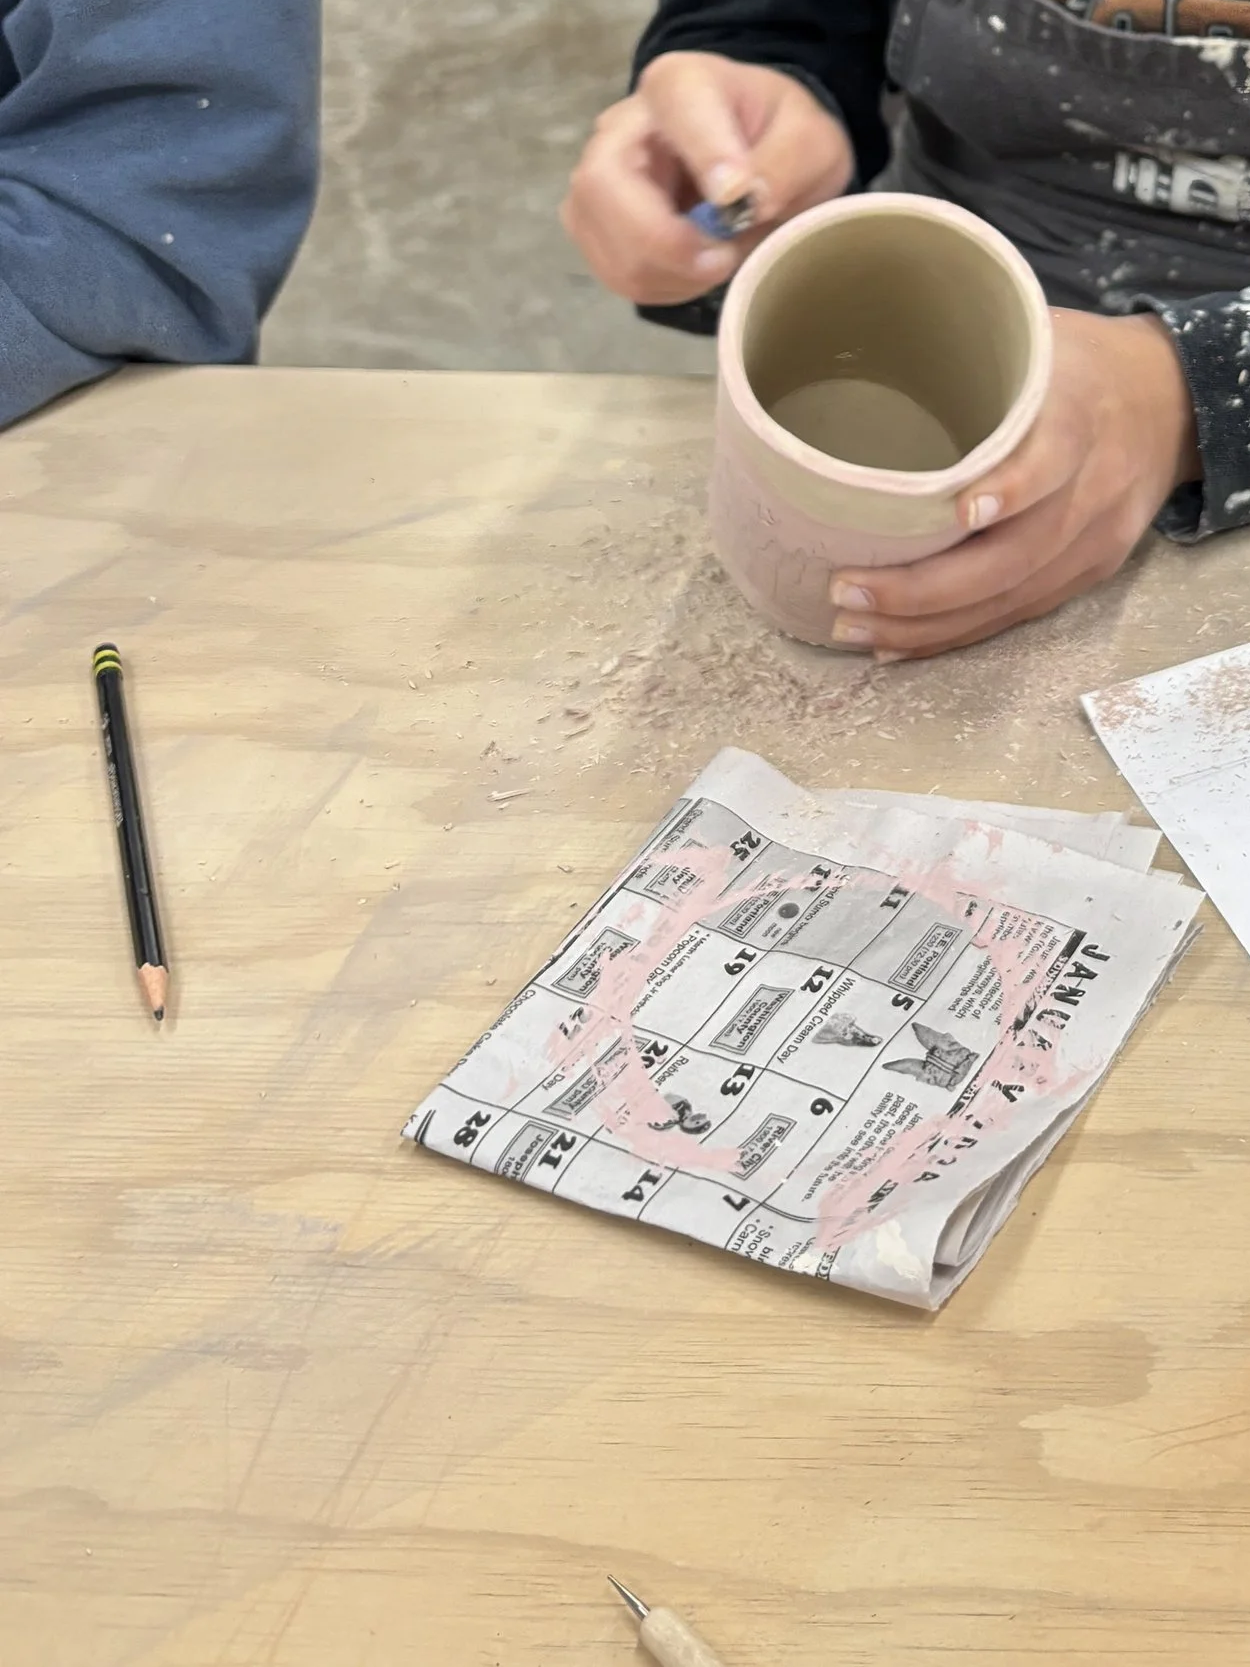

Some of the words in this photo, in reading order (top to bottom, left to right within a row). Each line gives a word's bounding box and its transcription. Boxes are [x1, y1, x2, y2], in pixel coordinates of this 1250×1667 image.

[729, 830, 766, 861] 25
[804, 898, 830, 921] Sumo
[879, 885, 909, 910] 11
[735, 898, 772, 932] Portland
[660, 933, 698, 967] Popcorn
[686, 937, 706, 955] Martin
[934, 930, 954, 948] S.E.
[669, 954, 690, 974] Luther
[723, 947, 757, 976] 19
[903, 950, 939, 986] Portland
[654, 973, 673, 987] King
[799, 965, 834, 993] 12
[818, 977, 856, 1015] Whipped
[891, 993, 915, 1011] 5
[947, 997, 963, 1012] and
[954, 997, 976, 1019] which
[488, 989, 536, 1031] Chocolate
[733, 990, 788, 1049] Washington
[736, 1000, 768, 1035] County
[793, 1015, 823, 1044] Cream
[776, 1044, 799, 1064] Day
[654, 1055, 690, 1087] Rubber
[720, 1063, 760, 1096] 13
[810, 1097, 834, 1116] 6
[870, 1091, 894, 1118] ability
[883, 1094, 905, 1117] past,
[891, 1102, 918, 1127] faces,
[453, 1110, 491, 1148] 28
[863, 1119, 876, 1129] to
[873, 1118, 890, 1134] the
[759, 1125, 787, 1152] River
[850, 1129, 867, 1146] see
[537, 1132, 577, 1170] 21
[740, 1151, 764, 1171] City
[836, 1146, 856, 1161] into
[621, 1169, 662, 1202] 14
[722, 1194, 751, 1212] 7
